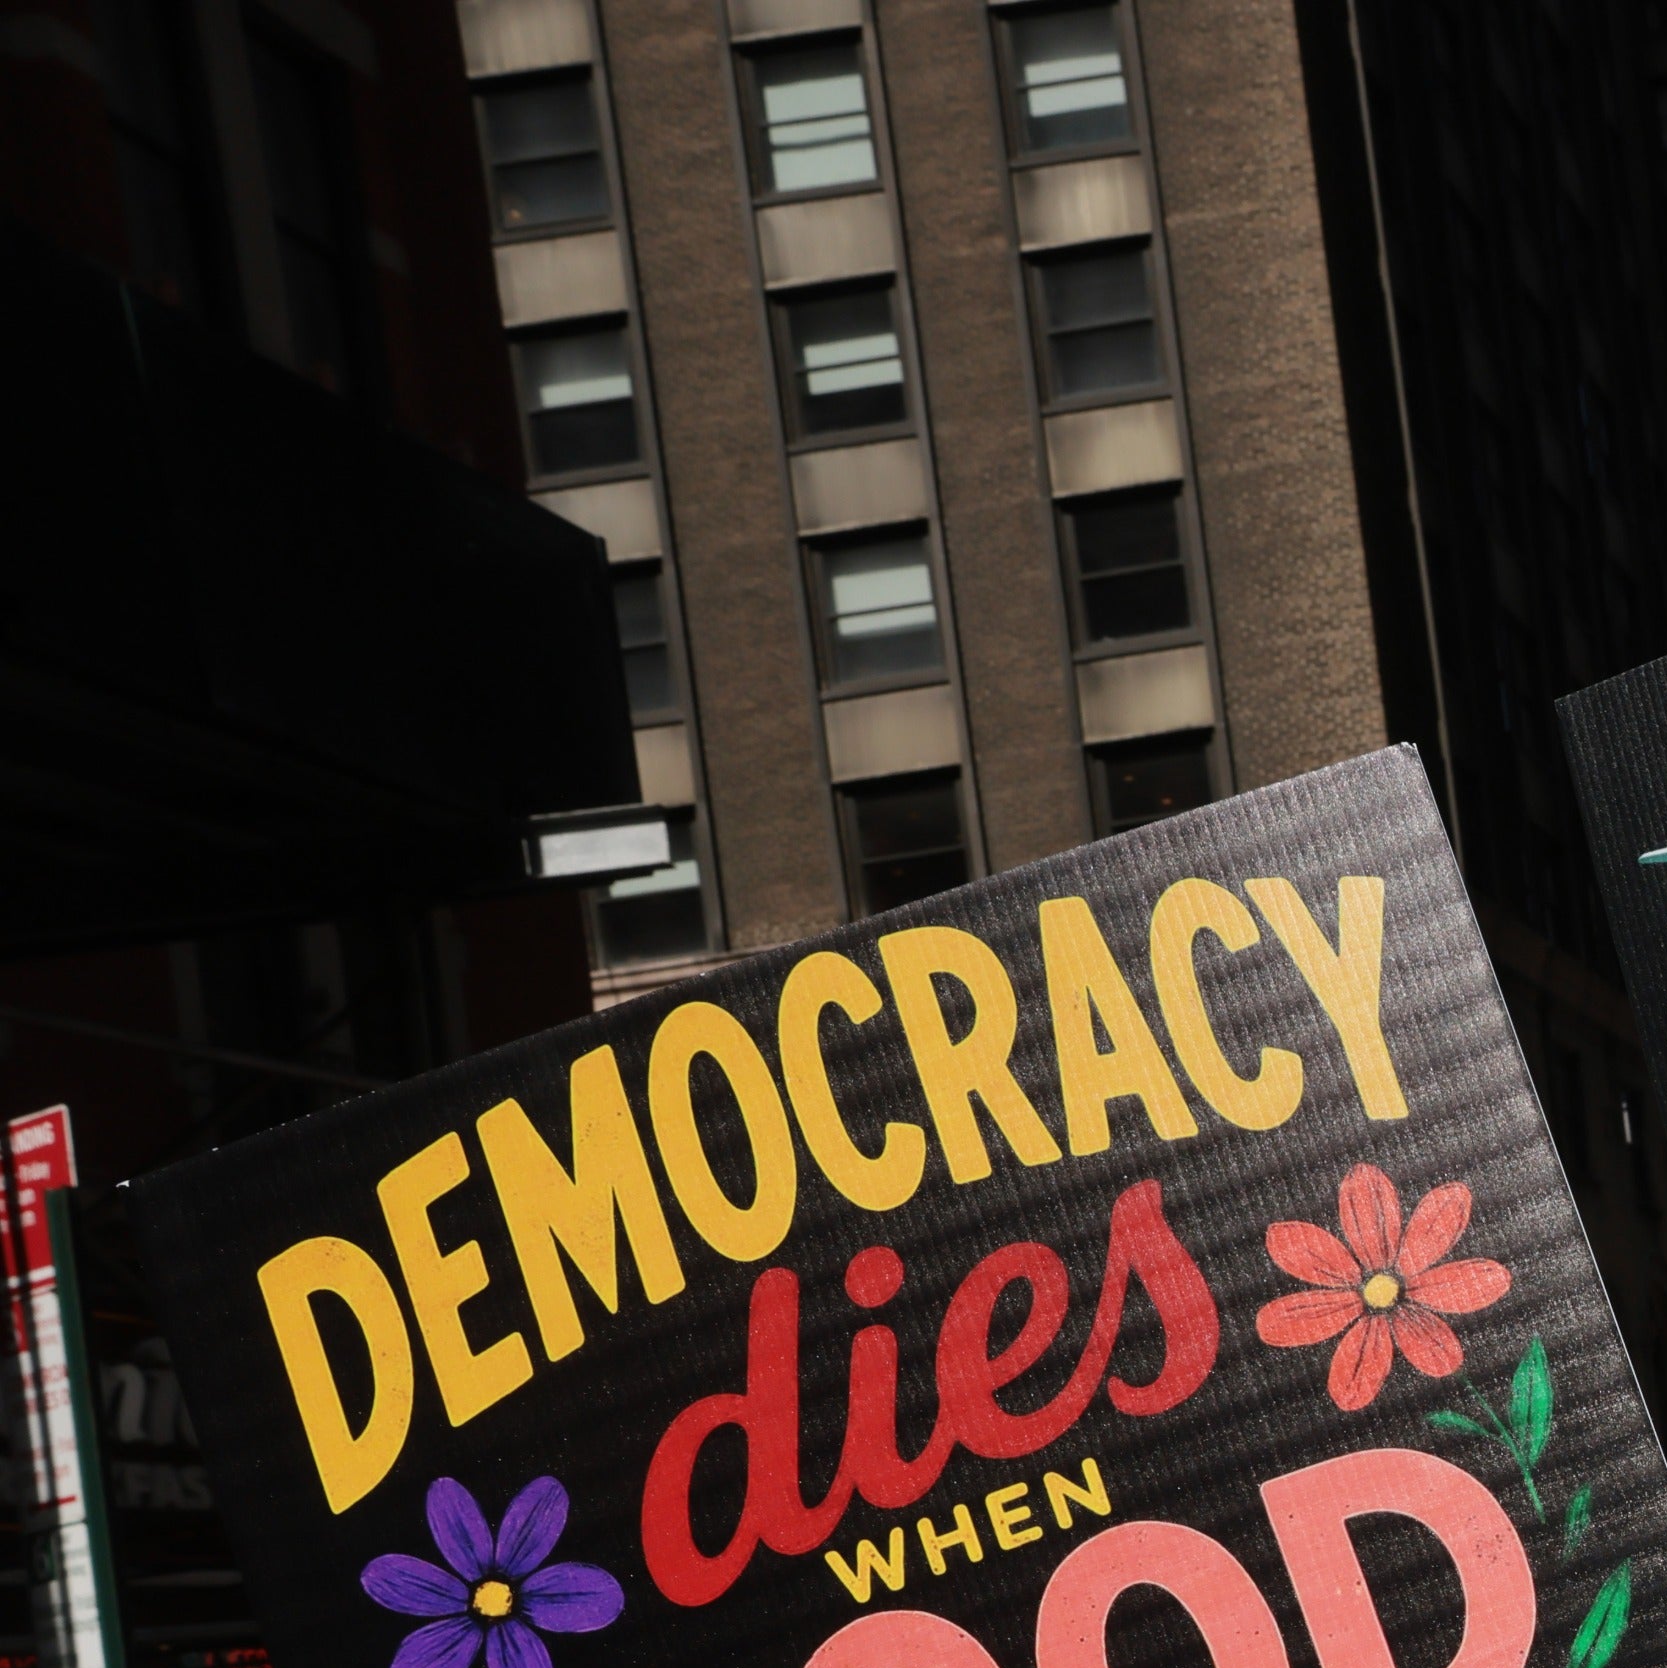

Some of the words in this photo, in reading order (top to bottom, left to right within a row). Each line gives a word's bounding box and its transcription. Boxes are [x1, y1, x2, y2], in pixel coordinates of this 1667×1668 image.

[256, 875, 1409, 1515] DEMOCRACY
[640, 1179, 1221, 1608] dies
[825, 1457, 1112, 1603] WHEN
